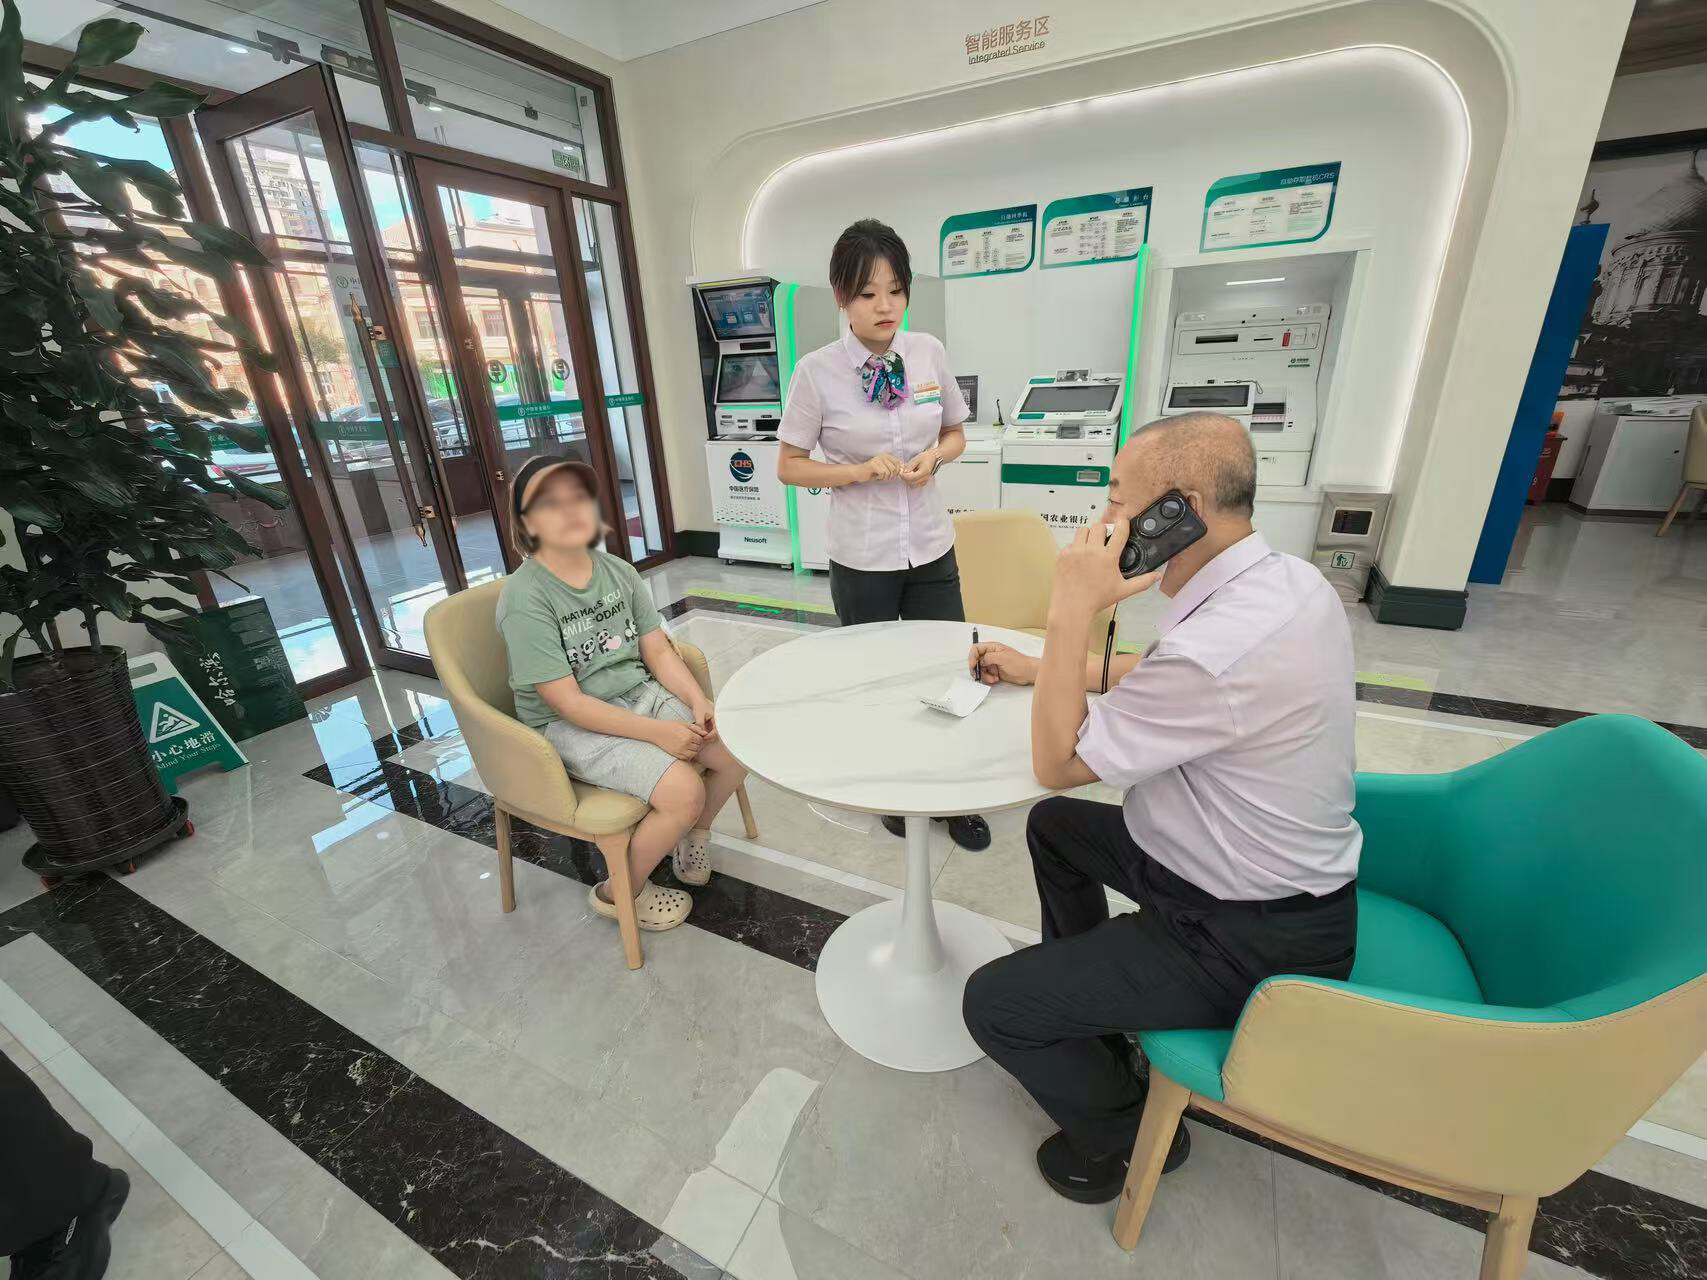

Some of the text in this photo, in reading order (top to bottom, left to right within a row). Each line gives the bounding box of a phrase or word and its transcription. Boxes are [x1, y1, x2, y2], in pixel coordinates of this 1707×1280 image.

[965, 15, 1050, 55] 智能服务区
[968, 40, 1046, 65] Integrated Service
[744, 536, 767, 544] Neusoft
[602, 589, 621, 605] YOU
[563, 601, 626, 640] SMILE ODAY?
[151, 731, 216, 762] 小心地滑
[157, 758, 179, 769] Mind
[179, 751, 199, 761] Your
